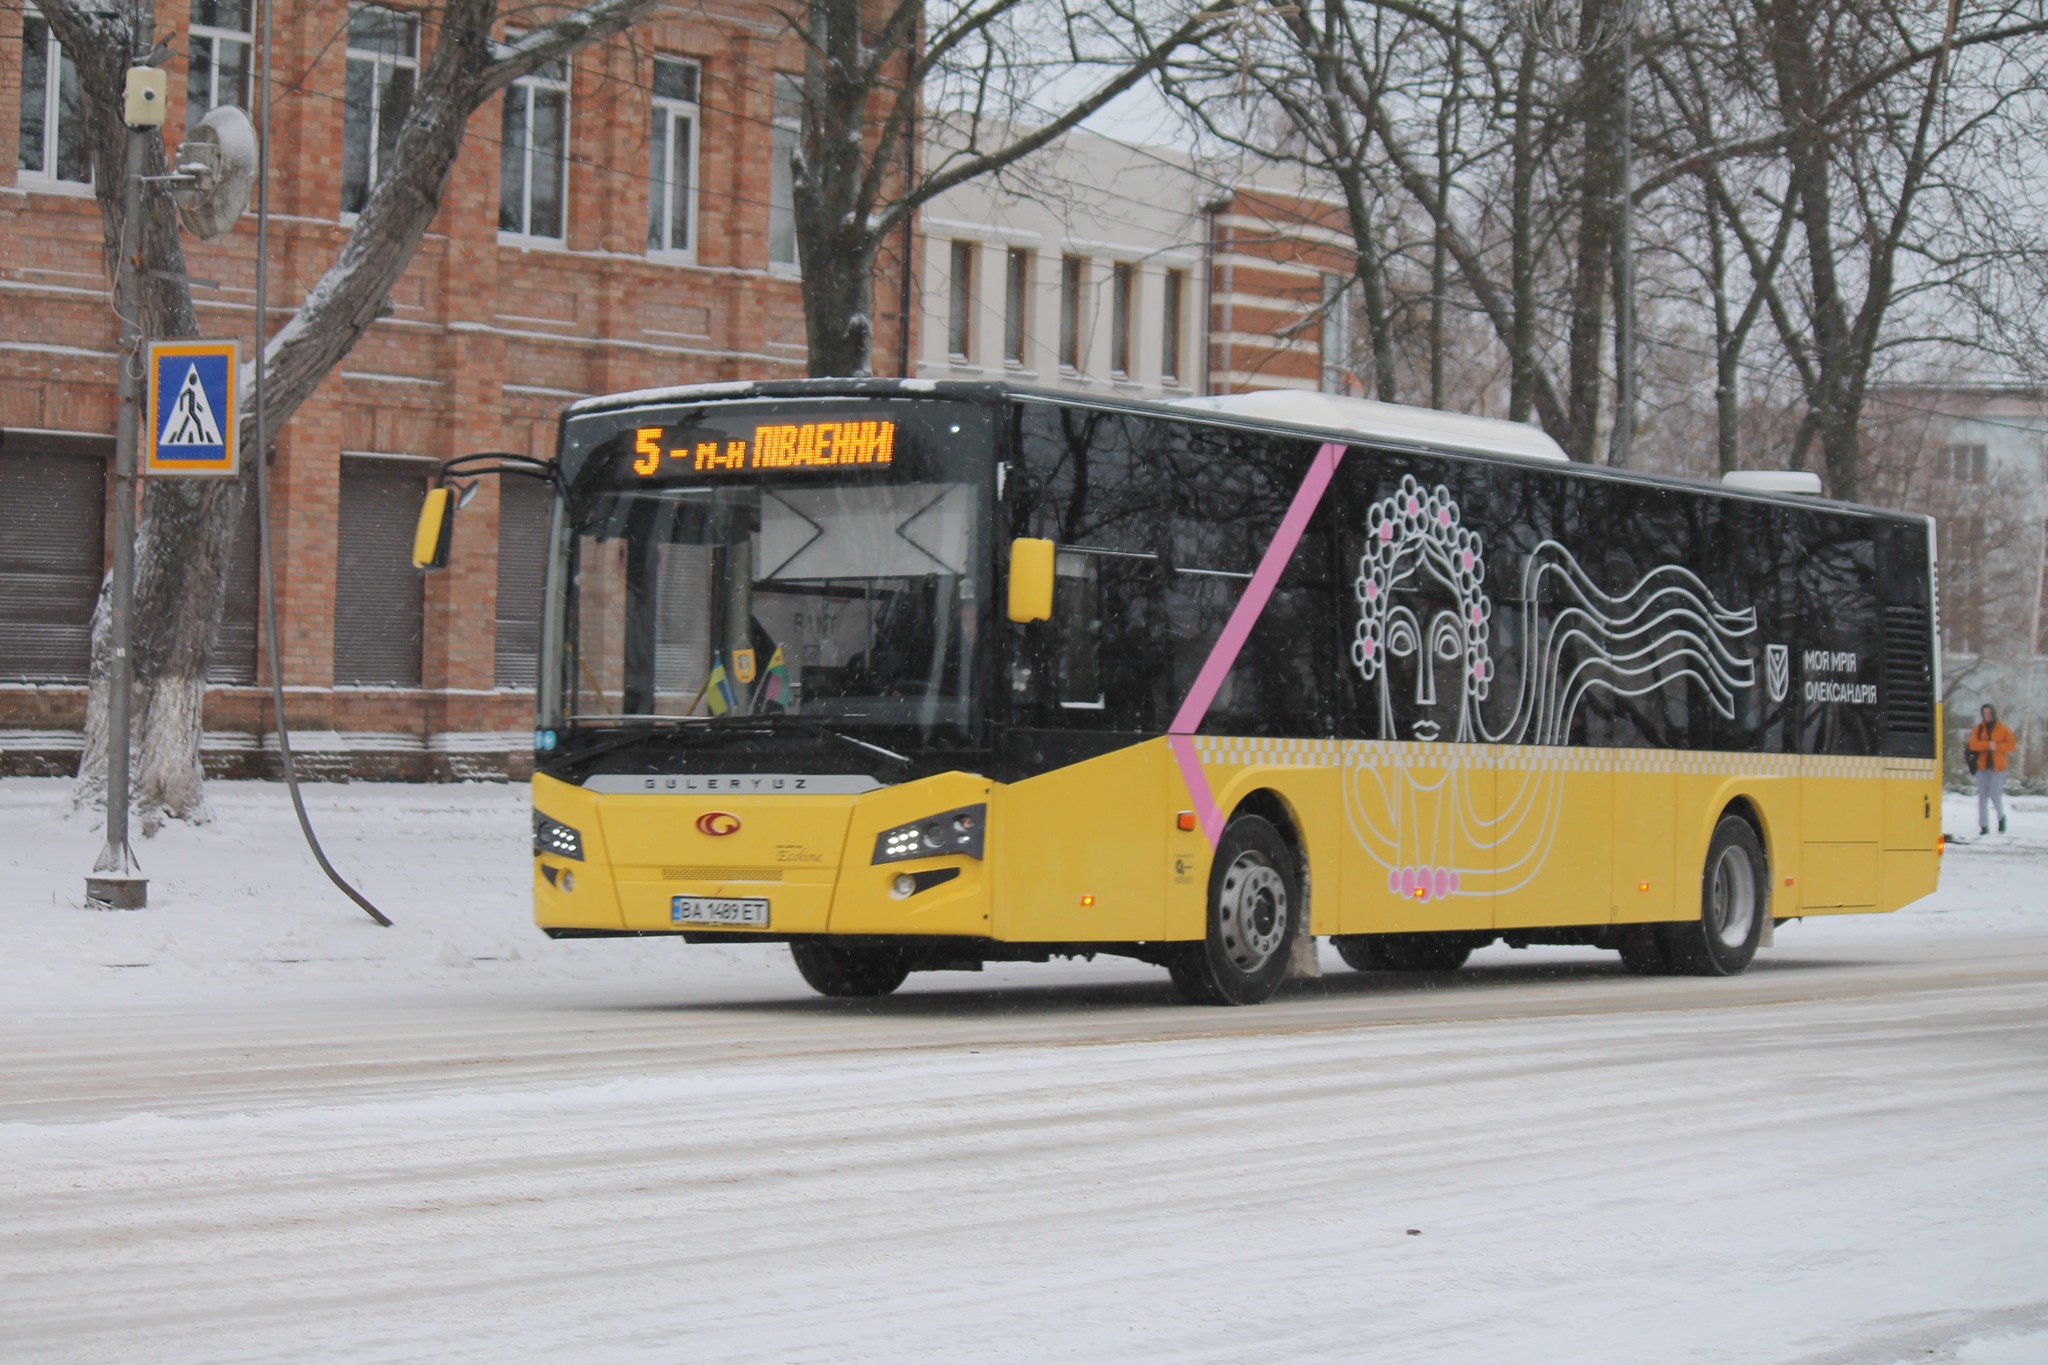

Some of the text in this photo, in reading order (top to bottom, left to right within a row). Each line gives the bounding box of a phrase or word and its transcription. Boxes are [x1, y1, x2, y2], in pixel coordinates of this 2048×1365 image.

[633, 428, 663, 475] 5
[1804, 649, 1857, 673] МОЯ МРІЯ
[1805, 681, 1877, 704] ОЛЕКСАНДРІЯ
[681, 901, 702, 919] BA
[707, 903, 739, 920] 1489
[742, 903, 764, 921] ET
